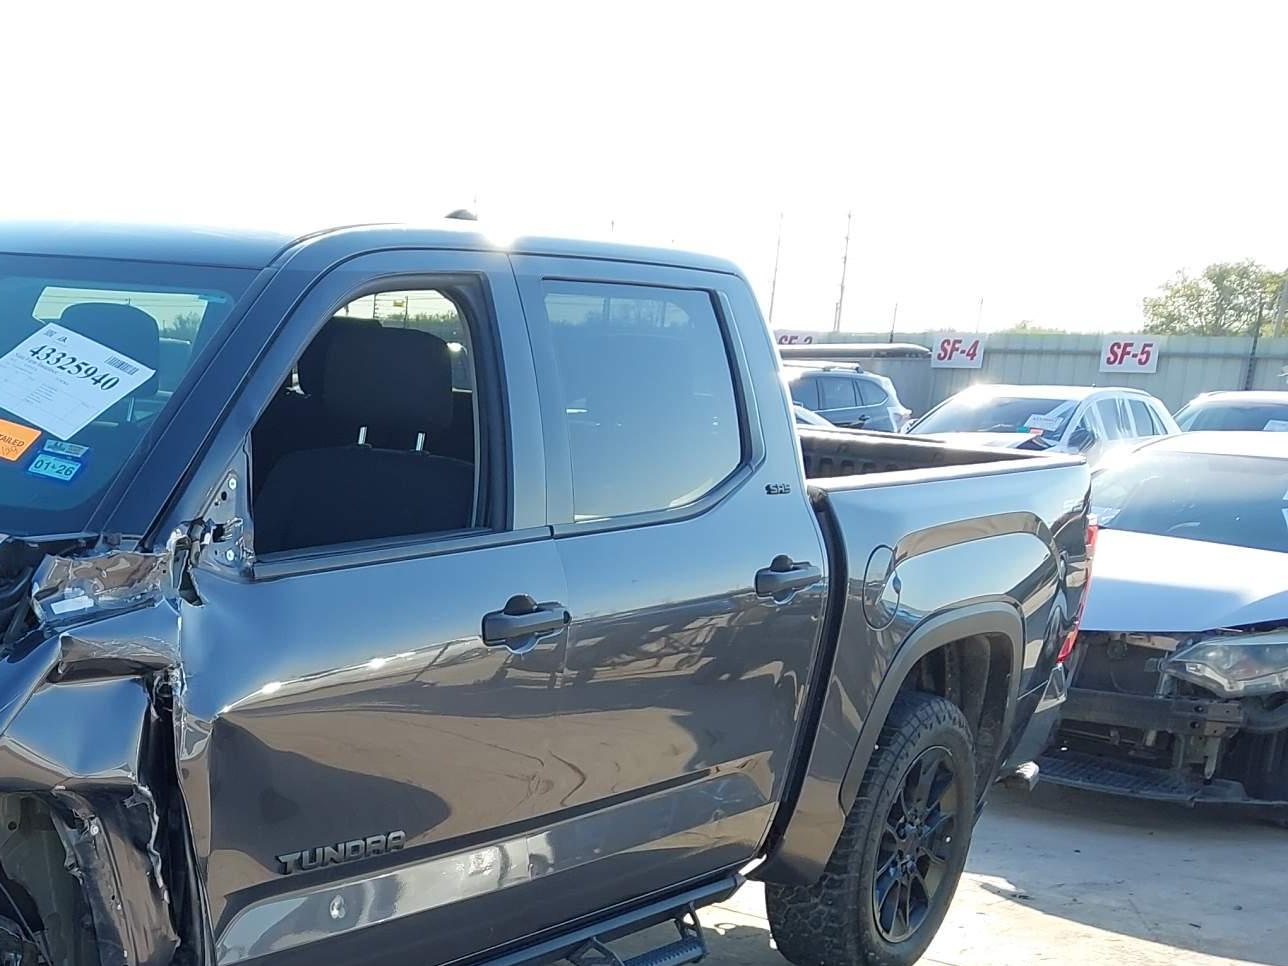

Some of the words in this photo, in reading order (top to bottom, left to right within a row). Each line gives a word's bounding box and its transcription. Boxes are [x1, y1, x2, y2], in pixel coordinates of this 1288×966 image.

[30, 344, 120, 390] 43325940
[937, 338, 980, 361] SF-4
[1106, 341, 1154, 366] SF-5
[275, 830, 407, 875] TUNDRA
